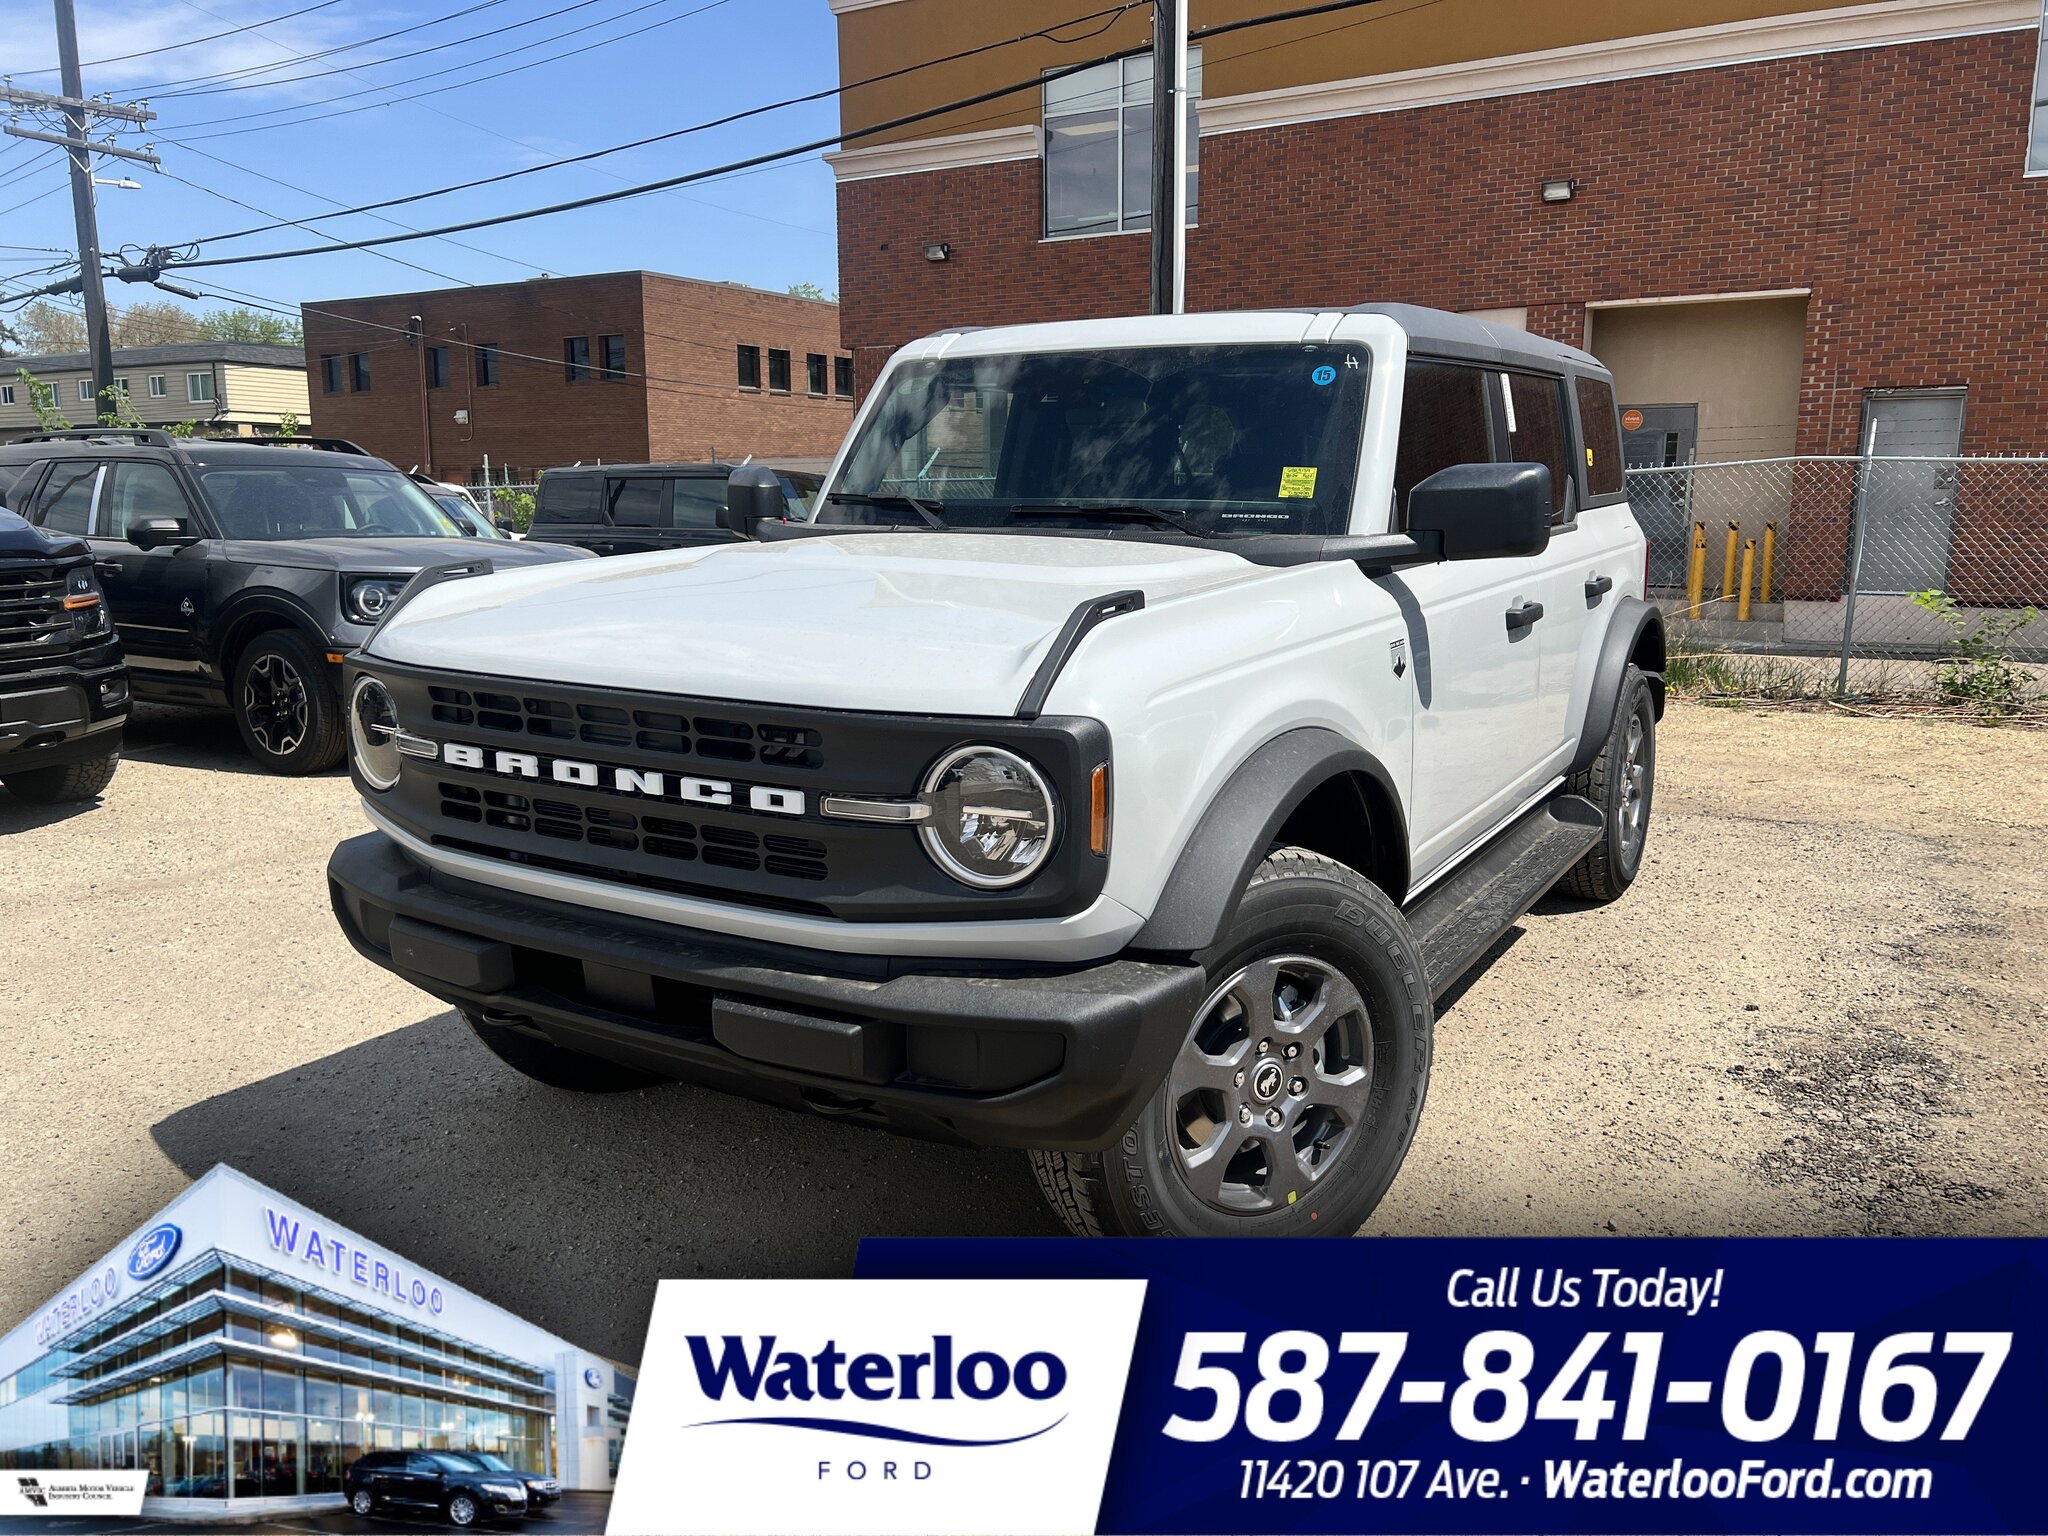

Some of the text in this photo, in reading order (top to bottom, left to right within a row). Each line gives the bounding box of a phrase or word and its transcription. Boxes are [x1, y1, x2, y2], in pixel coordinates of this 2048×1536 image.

[1317, 369, 1332, 381] 15
[443, 741, 806, 815] BRONCO
[1334, 898, 1428, 1080] DUELER
